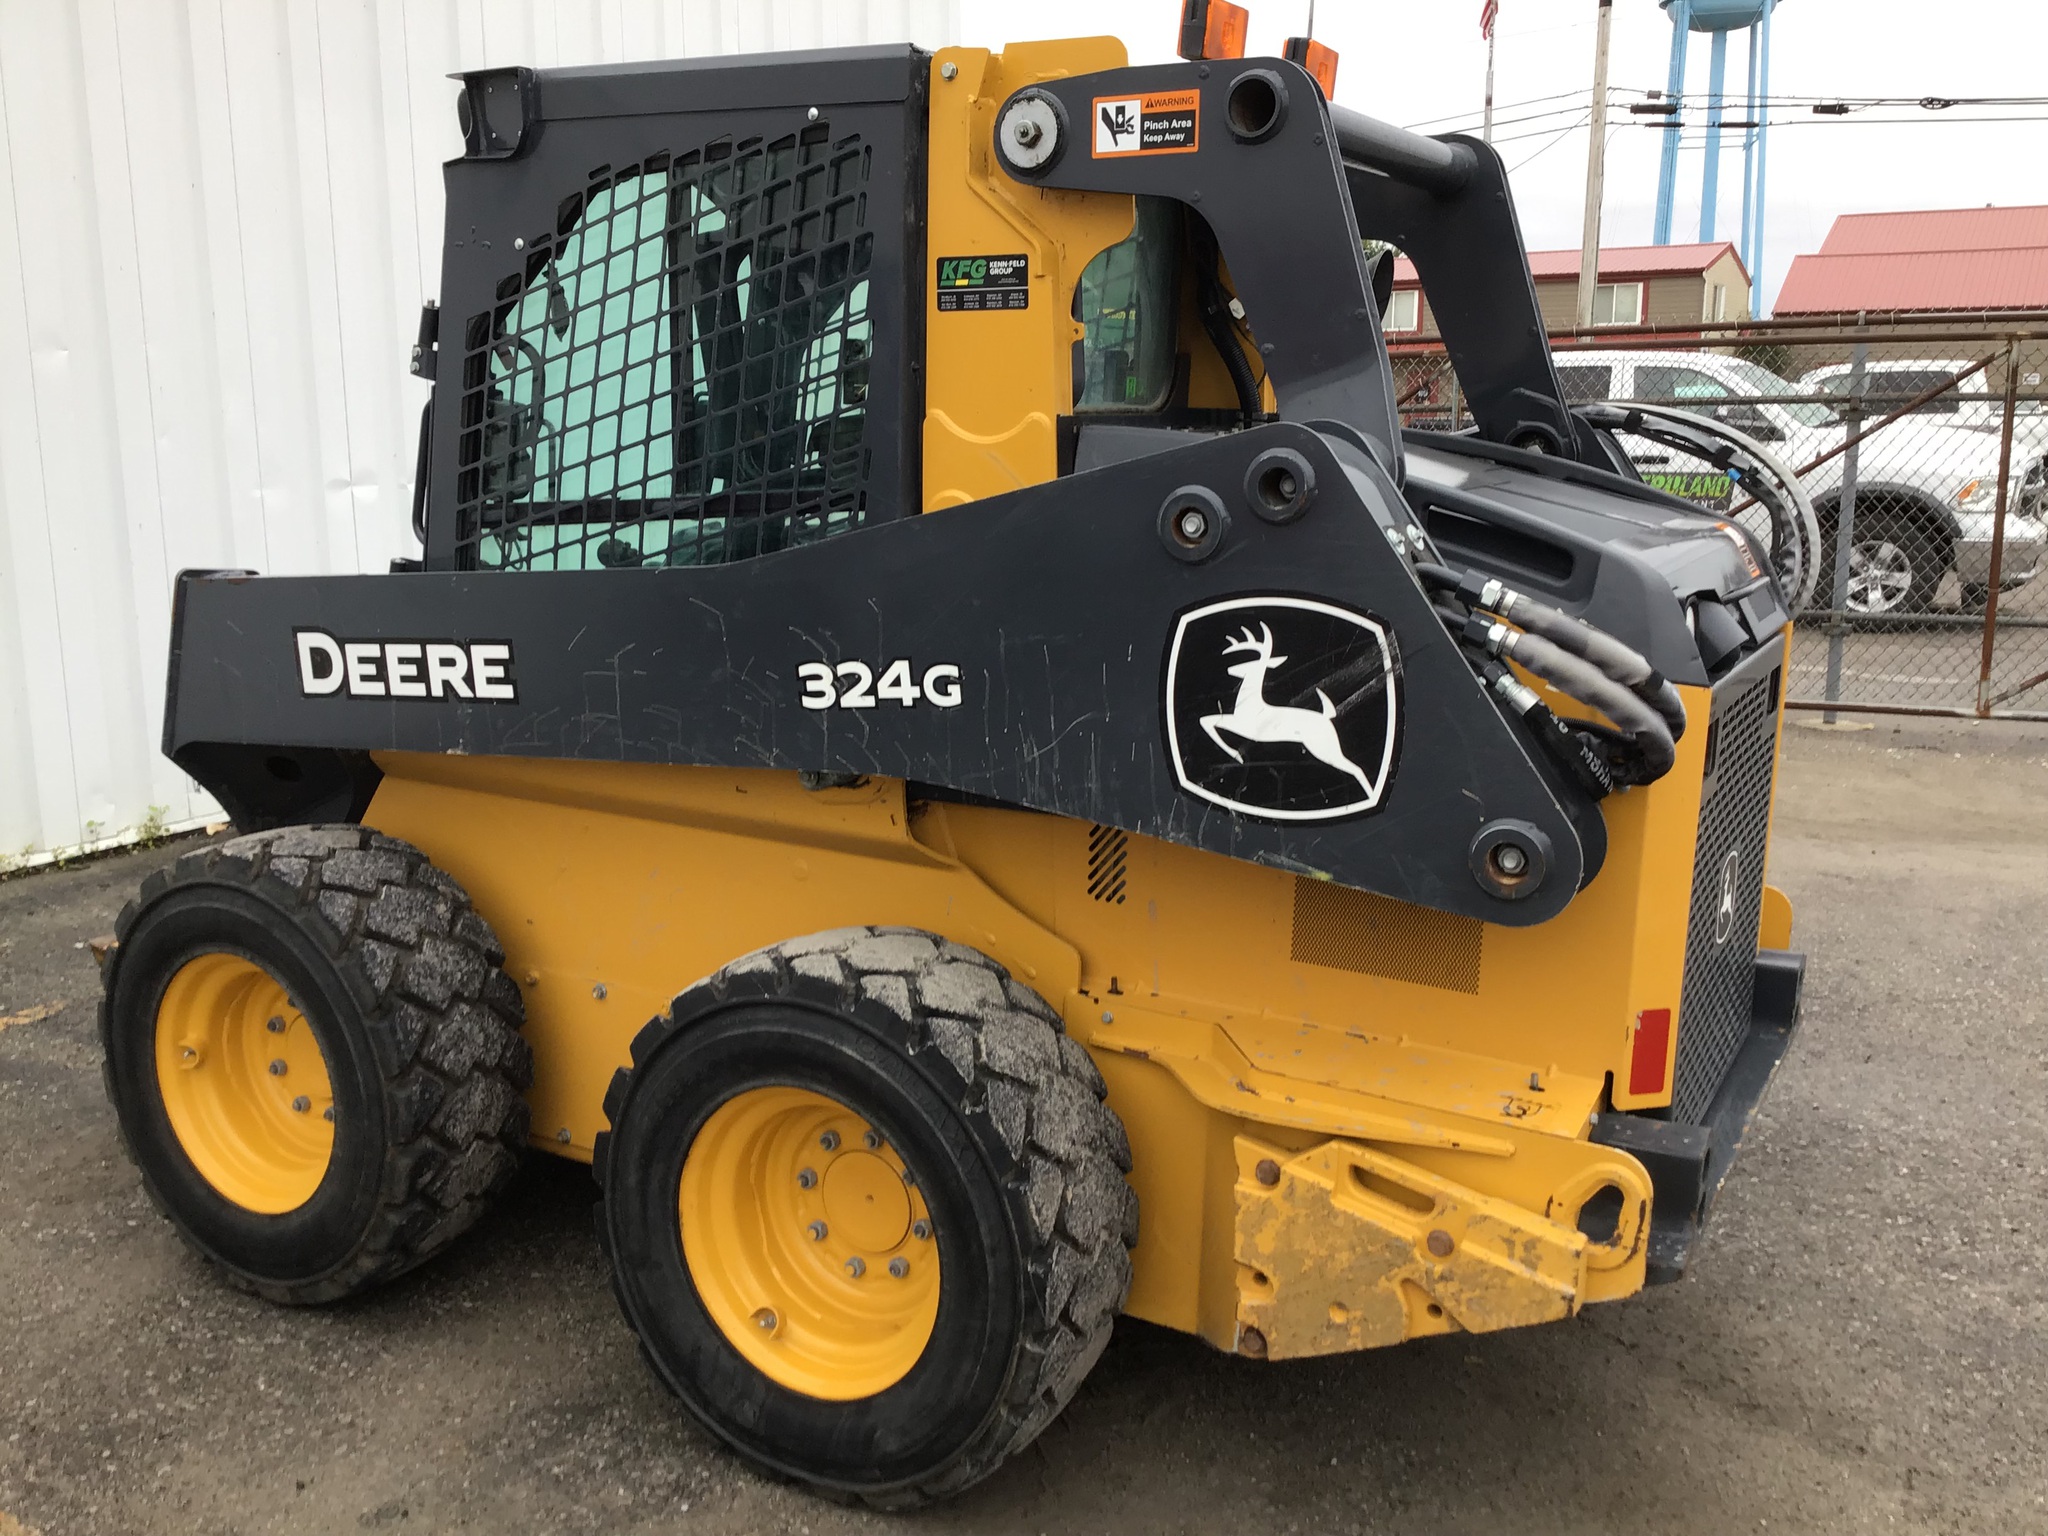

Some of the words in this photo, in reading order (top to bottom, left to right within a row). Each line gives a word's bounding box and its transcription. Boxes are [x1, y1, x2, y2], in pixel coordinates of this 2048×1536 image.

[1154, 96, 1194, 107] WARNING
[1144, 120, 1169, 130] Pinch
[1171, 118, 1192, 128] Area
[1143, 133, 1163, 143] Keep
[1164, 132, 1185, 141] Away
[941, 259, 987, 280] KFG
[989, 267, 1014, 275] GROUP
[296, 631, 515, 699] DEERE
[798, 660, 962, 709] 324G
